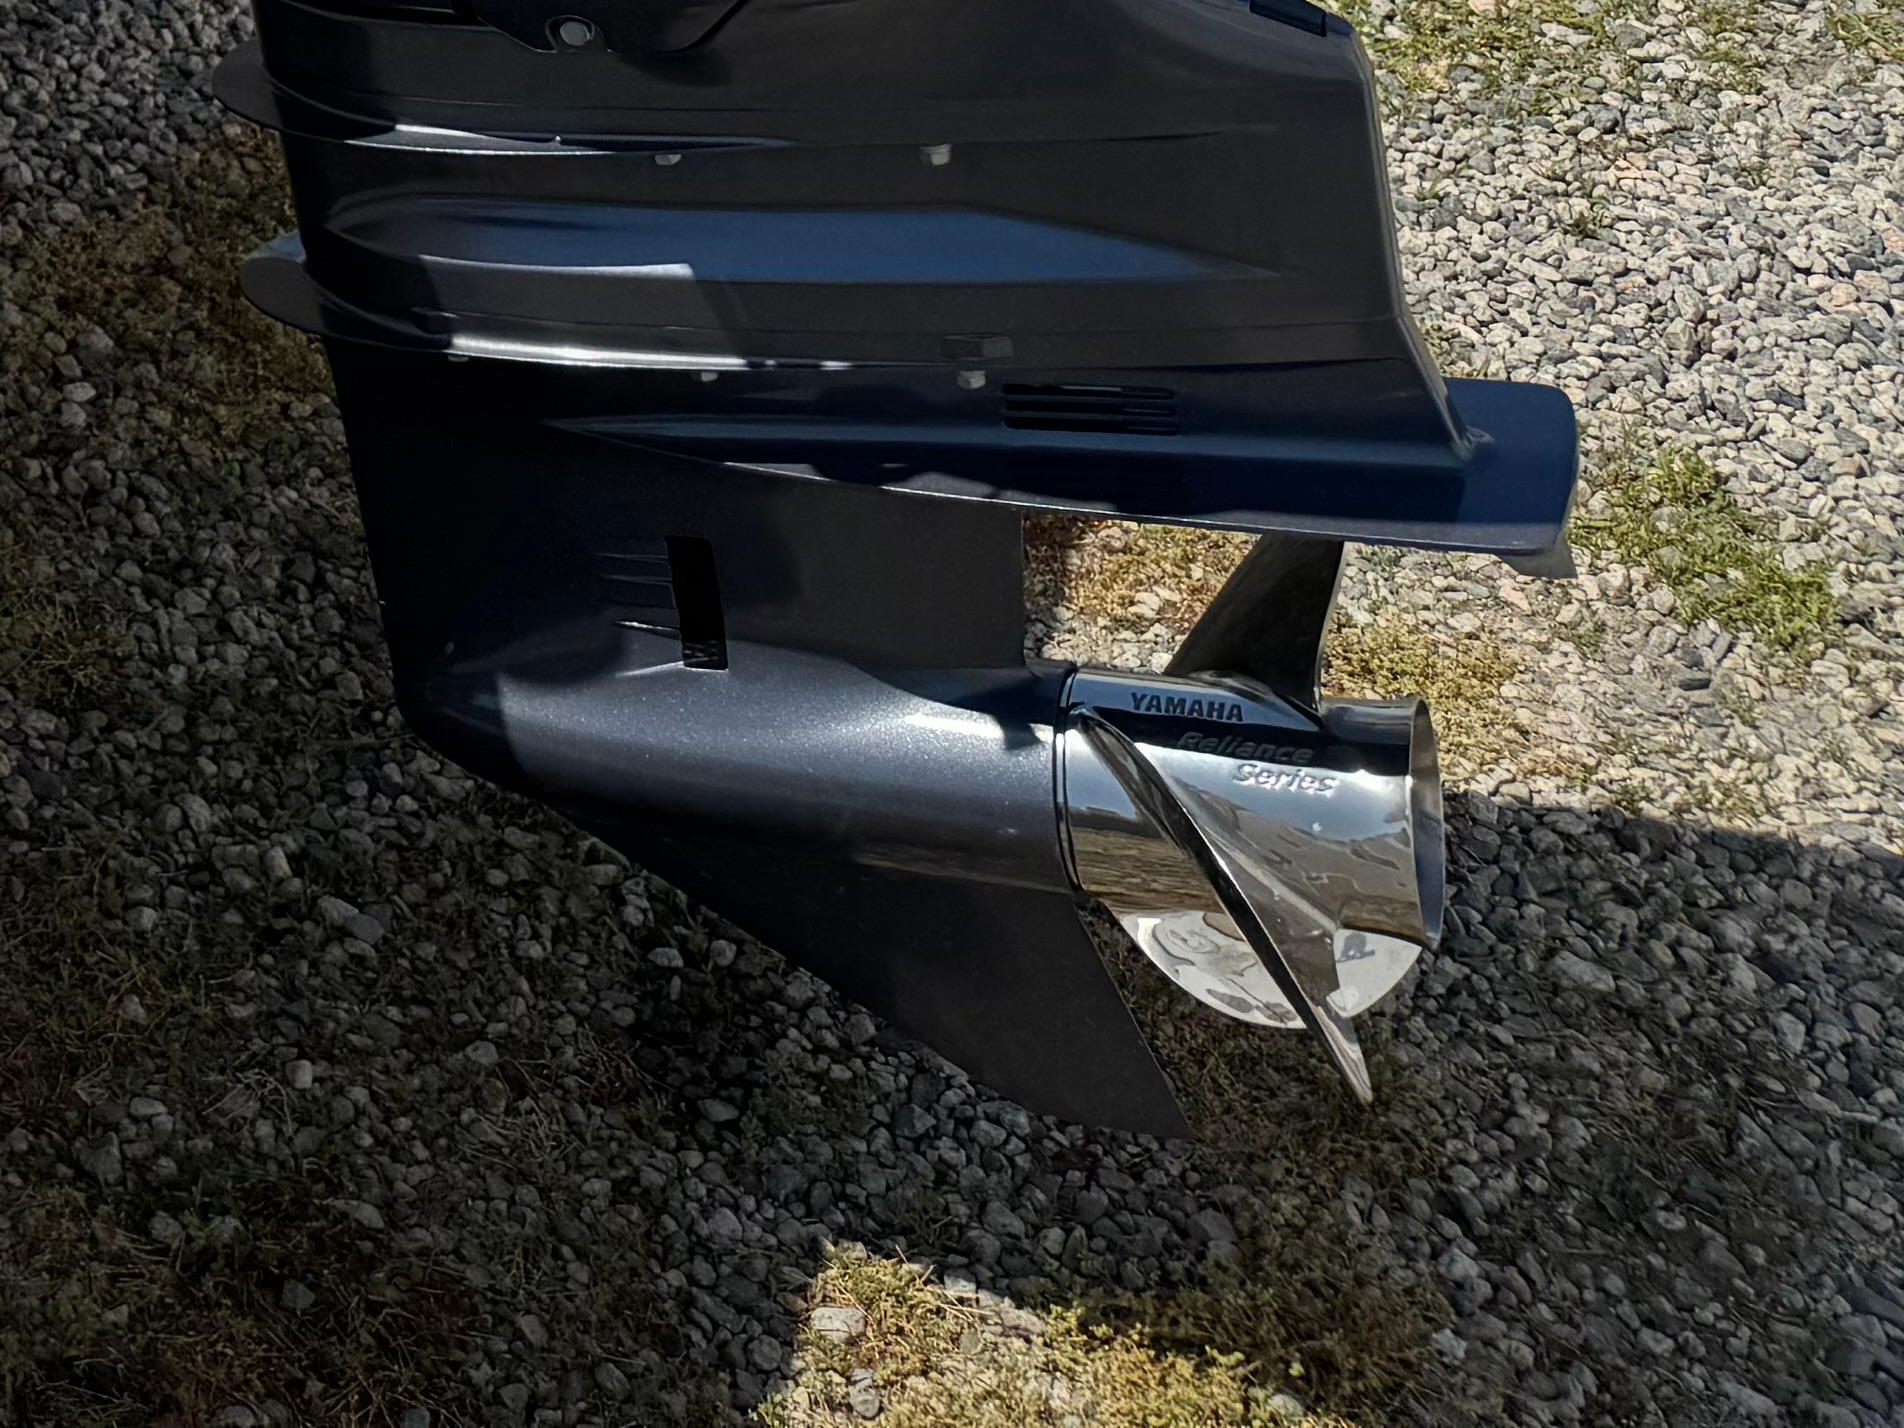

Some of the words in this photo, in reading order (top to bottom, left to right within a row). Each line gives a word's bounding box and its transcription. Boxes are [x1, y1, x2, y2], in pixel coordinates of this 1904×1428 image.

[1131, 692, 1244, 723] YAMAHA
[1178, 731, 1314, 765] Reliance
[1234, 762, 1337, 794] Series
